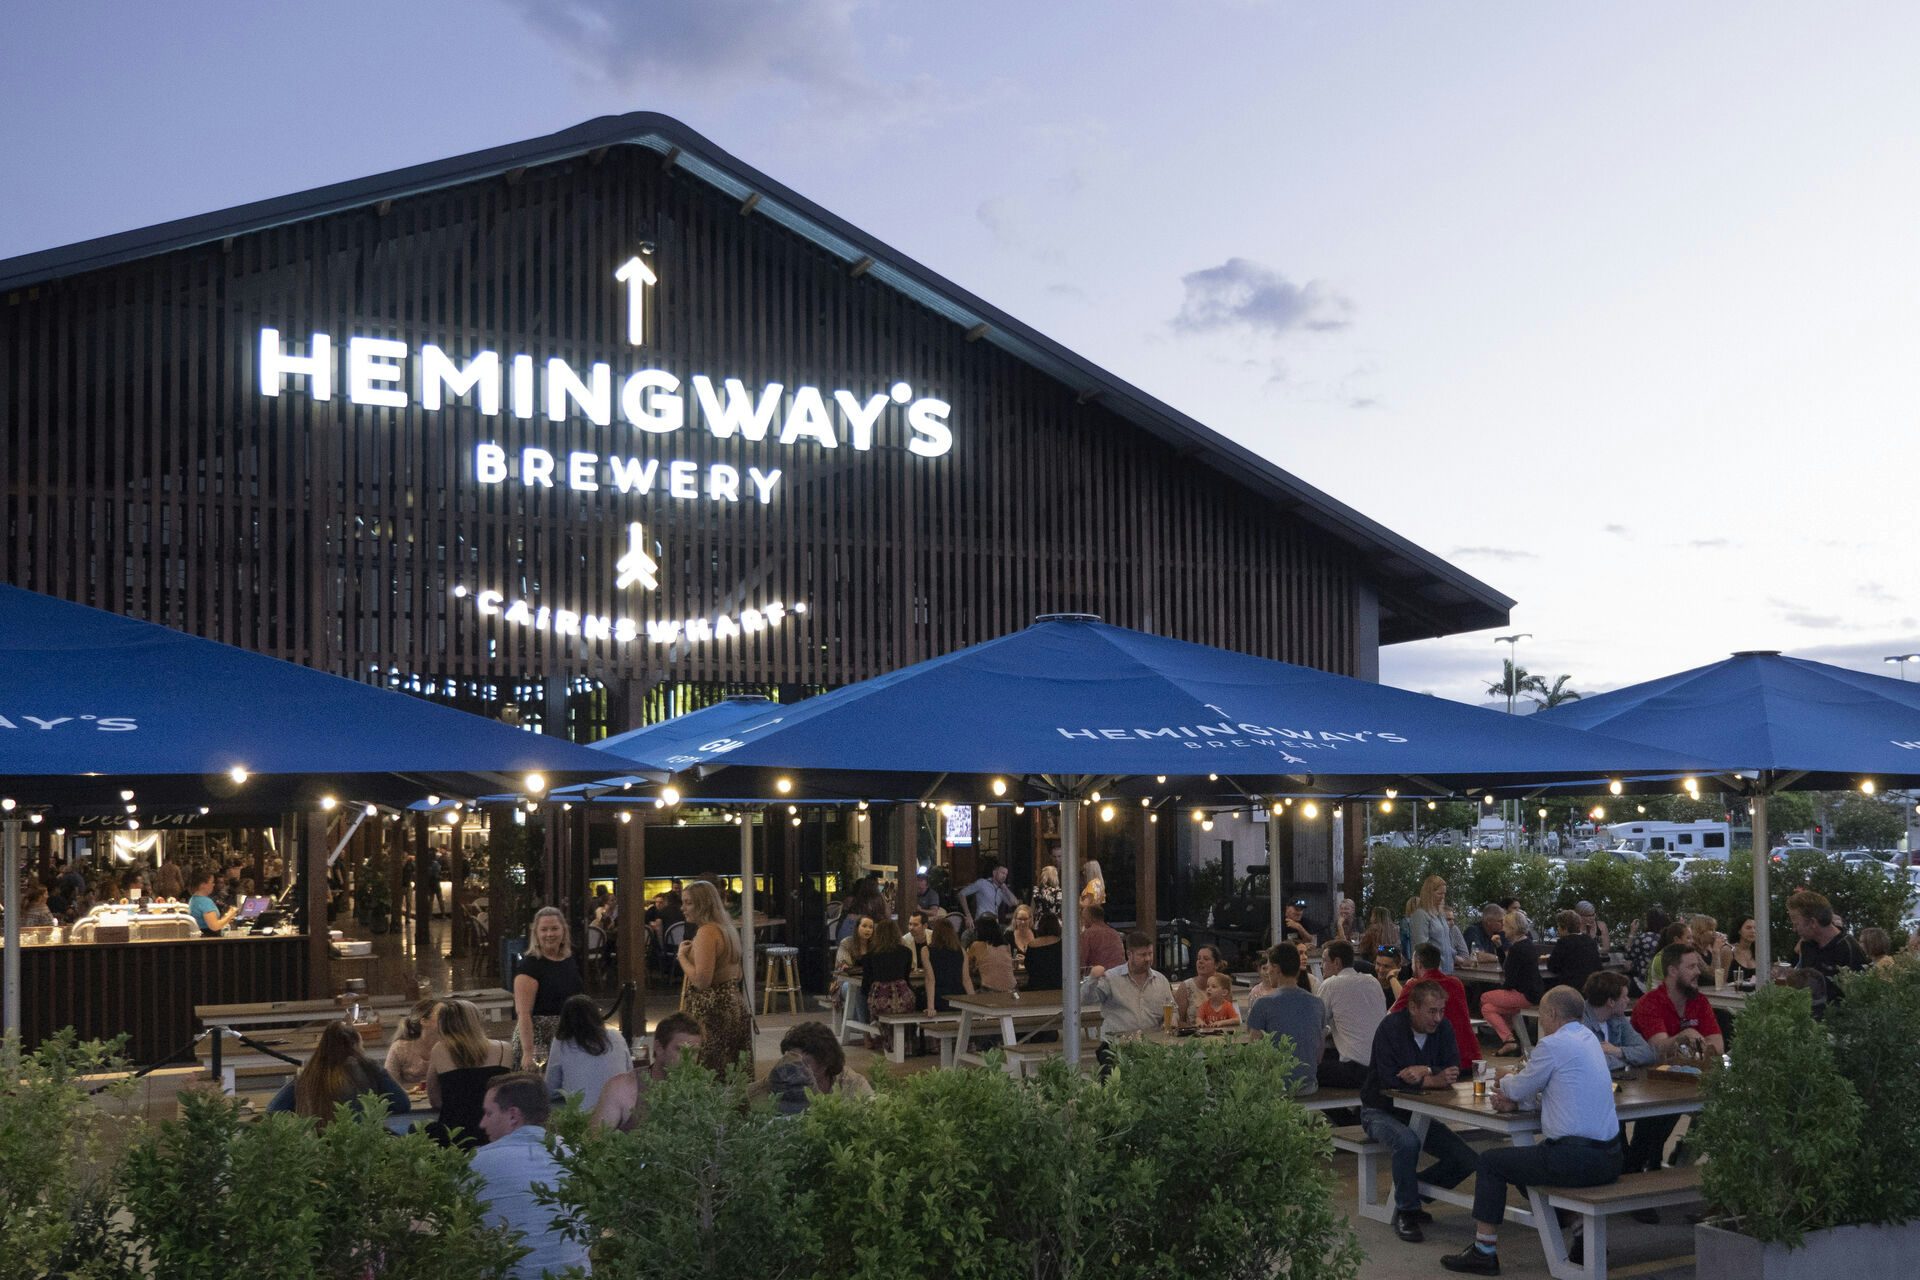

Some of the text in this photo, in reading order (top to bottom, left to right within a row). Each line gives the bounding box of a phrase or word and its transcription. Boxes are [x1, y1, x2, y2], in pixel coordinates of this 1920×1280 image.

[260, 329, 953, 457] HEMINGWAY'S
[476, 441, 783, 505] BREWERY
[477, 589, 787, 644] CAIRNS WHARF
[1056, 722, 1409, 744] HEMINGWAY'S
[1182, 737, 1338, 750] BREWERY
